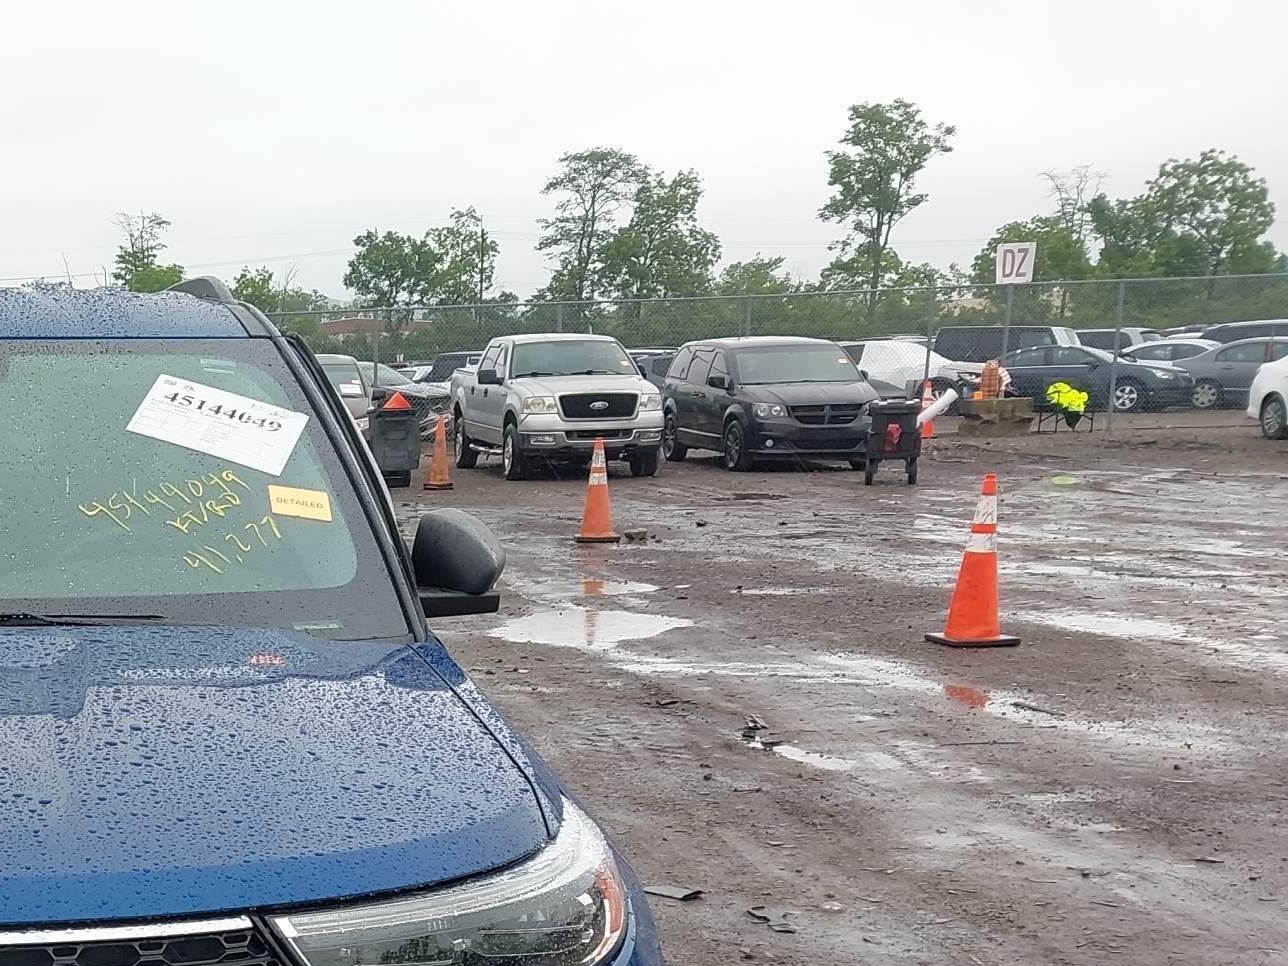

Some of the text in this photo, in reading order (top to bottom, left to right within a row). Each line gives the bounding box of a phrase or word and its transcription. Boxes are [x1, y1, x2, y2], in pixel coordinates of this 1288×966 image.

[1002, 247, 1031, 279] DZ
[163, 391, 283, 433] 45144049
[275, 496, 324, 509] DETAILED
